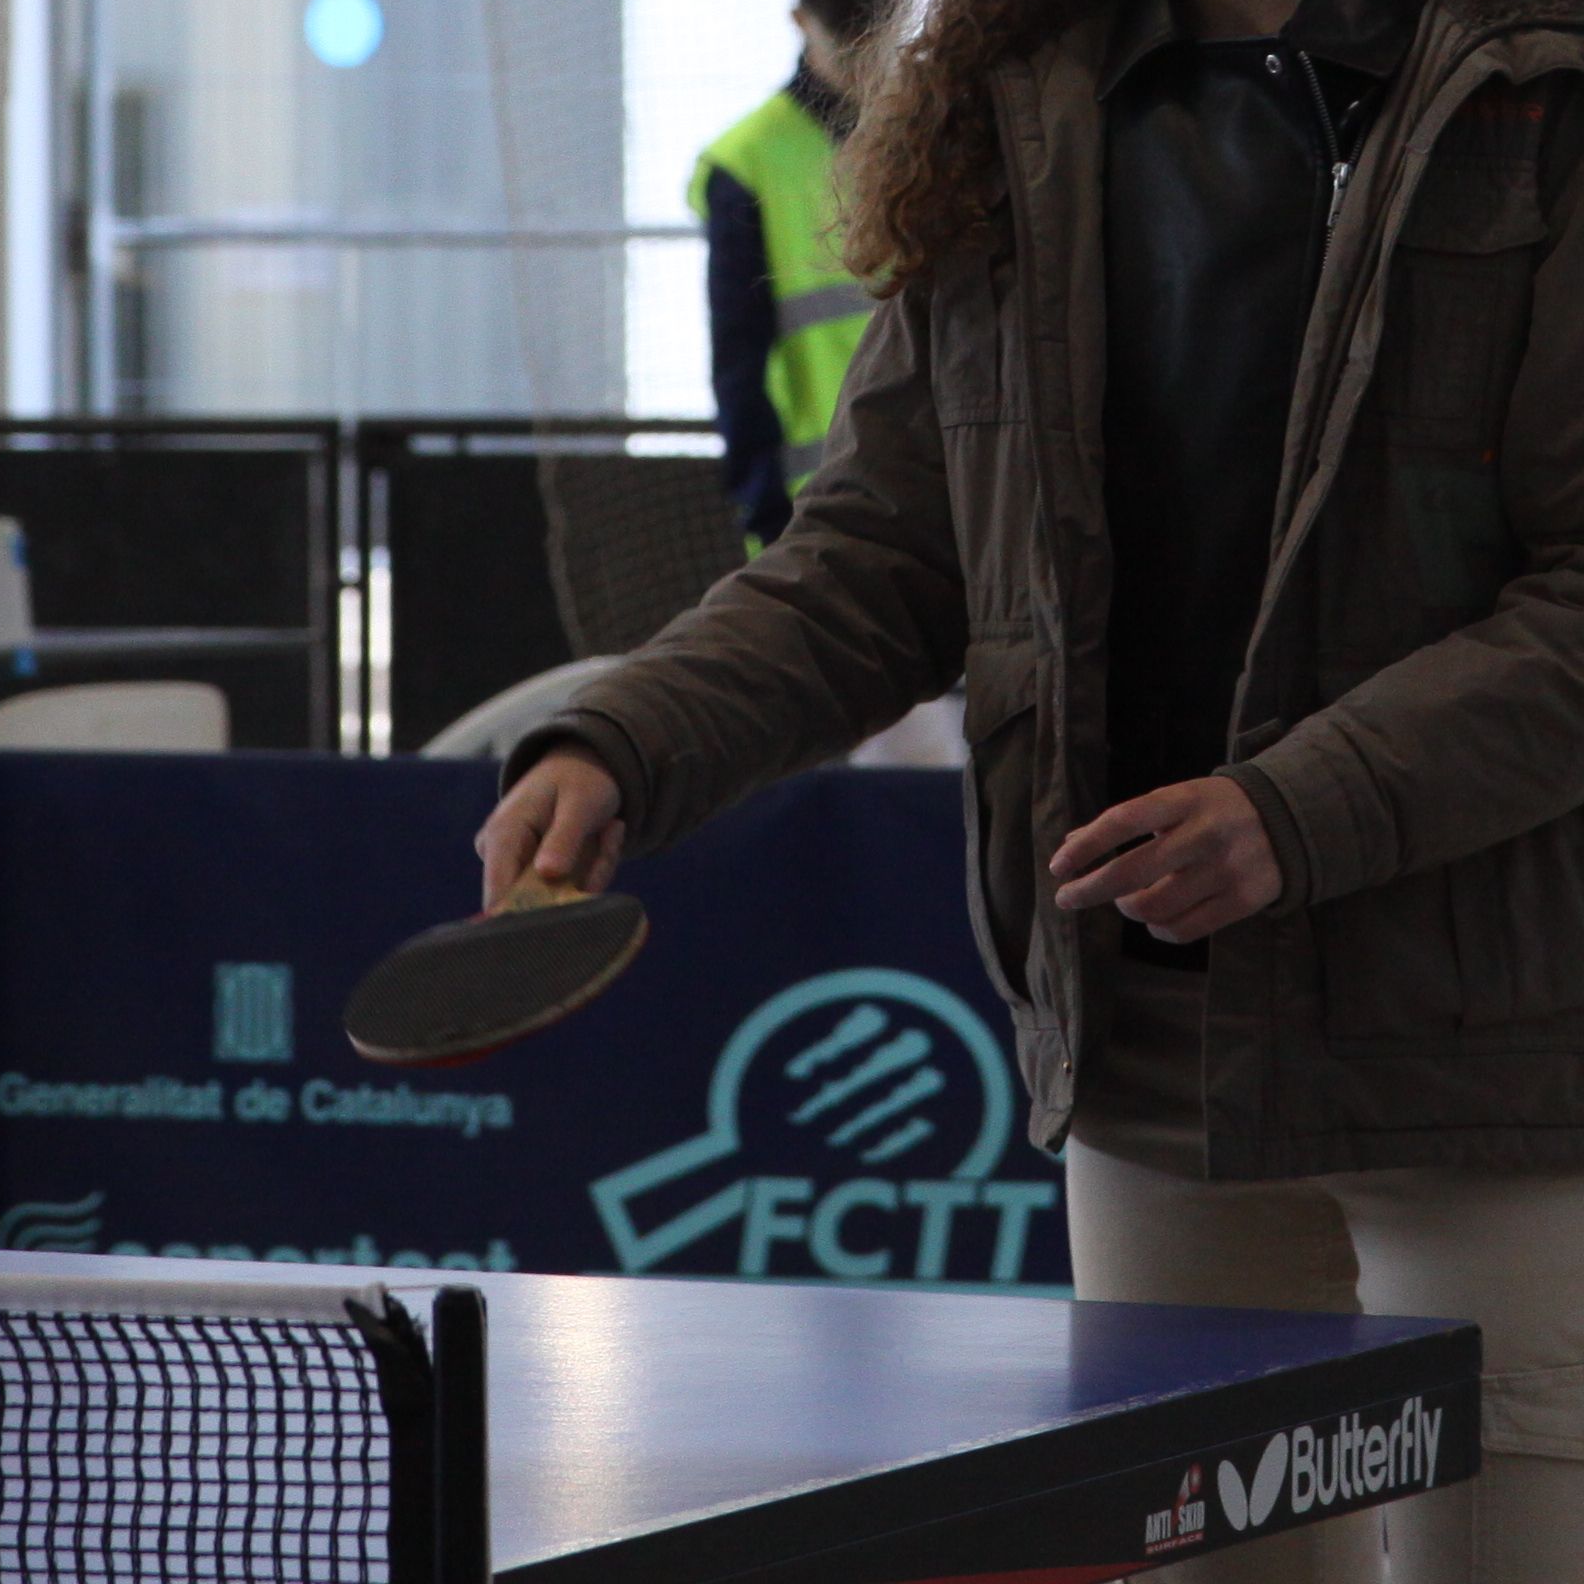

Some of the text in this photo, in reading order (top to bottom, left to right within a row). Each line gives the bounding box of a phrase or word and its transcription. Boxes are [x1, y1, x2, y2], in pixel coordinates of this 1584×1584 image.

[233, 1077, 293, 1122] de
[300, 1079, 514, 1138] Catalunya
[738, 1176, 1059, 1282] FCTT
[1291, 1395, 1443, 1514] Butterfly
[1145, 1509, 1172, 1544] ANTI
